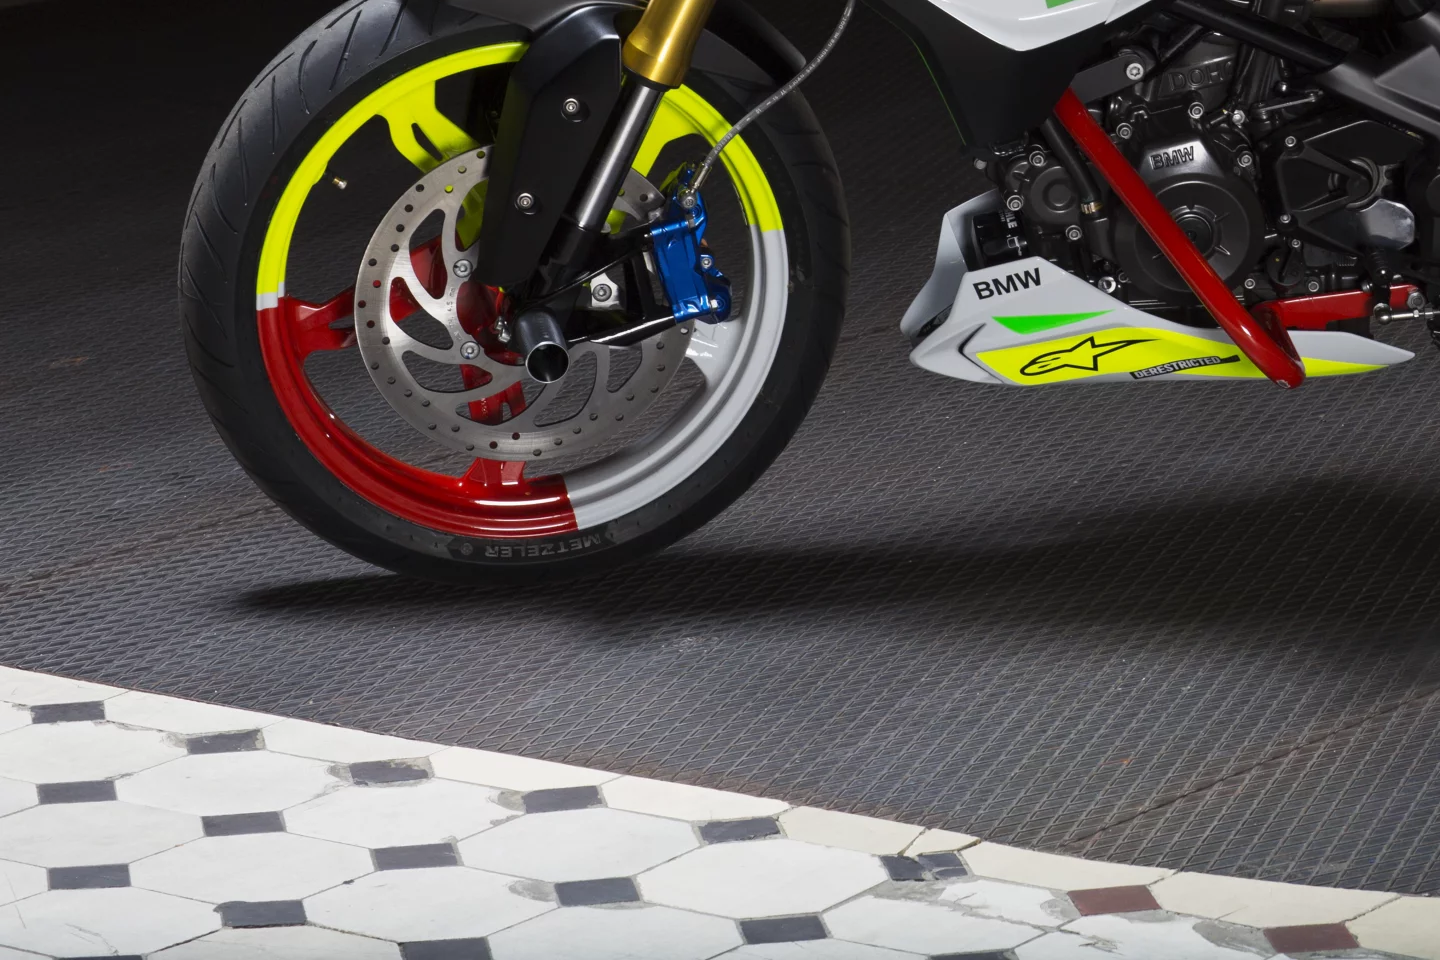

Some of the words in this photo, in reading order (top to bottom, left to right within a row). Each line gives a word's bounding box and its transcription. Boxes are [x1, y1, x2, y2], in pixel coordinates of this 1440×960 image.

[1149, 145, 1195, 171] BMW
[973, 267, 1041, 300] BMW
[1133, 356, 1221, 379] DERESTRICTED
[485, 533, 601, 558] METZELER
